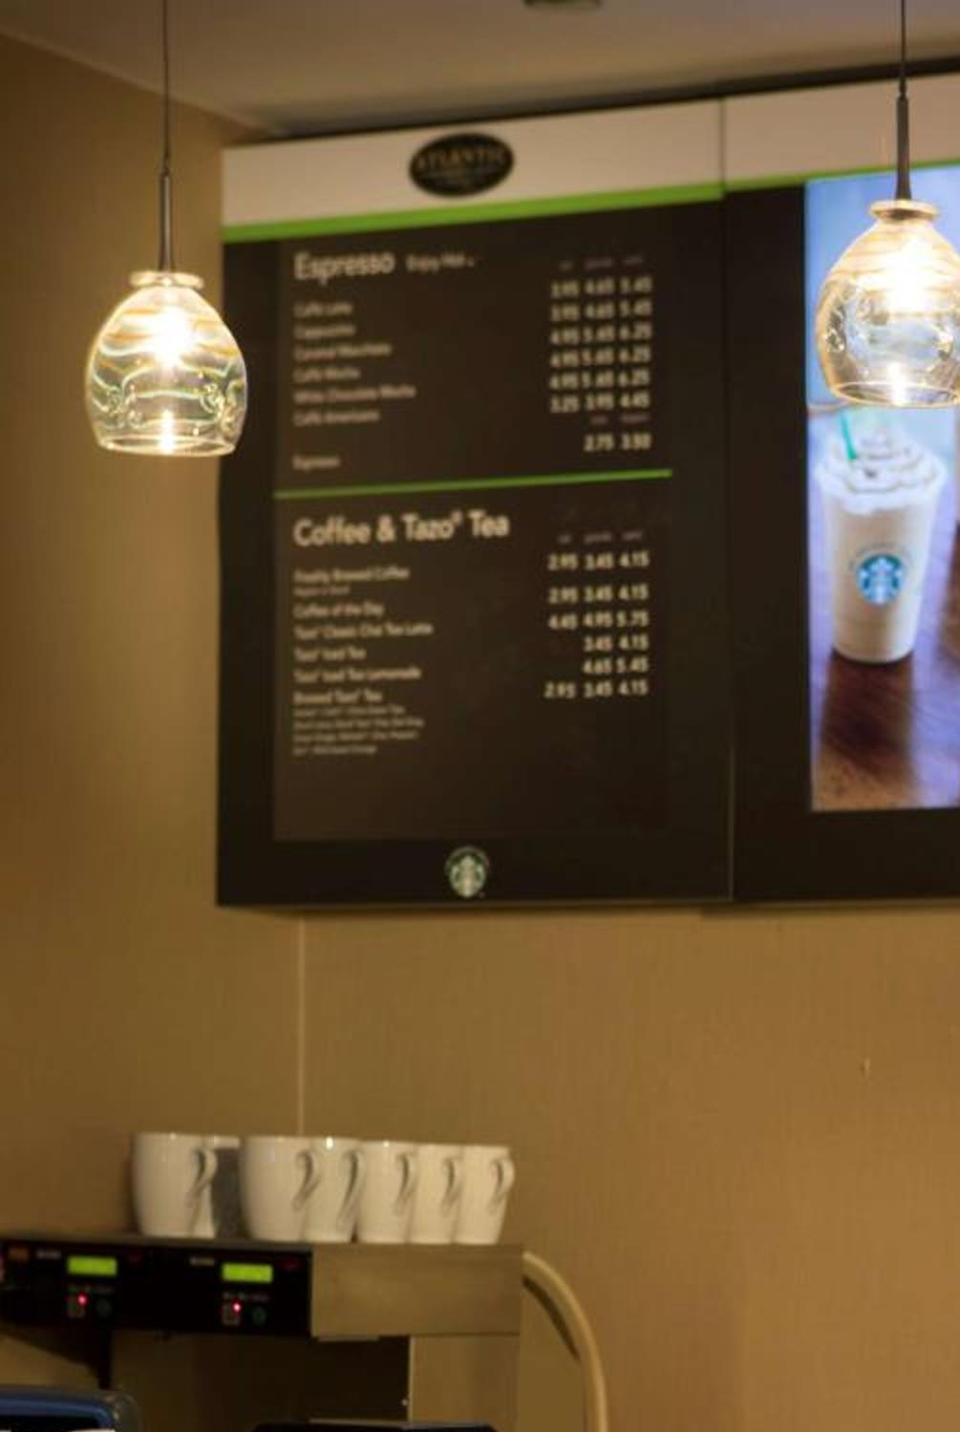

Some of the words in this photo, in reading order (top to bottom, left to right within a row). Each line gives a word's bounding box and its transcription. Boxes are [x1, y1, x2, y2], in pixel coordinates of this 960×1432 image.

[294, 251, 395, 287] Espresso
[293, 516, 371, 546] Coffee
[376, 514, 397, 543] &
[466, 508, 510, 538] Tea
